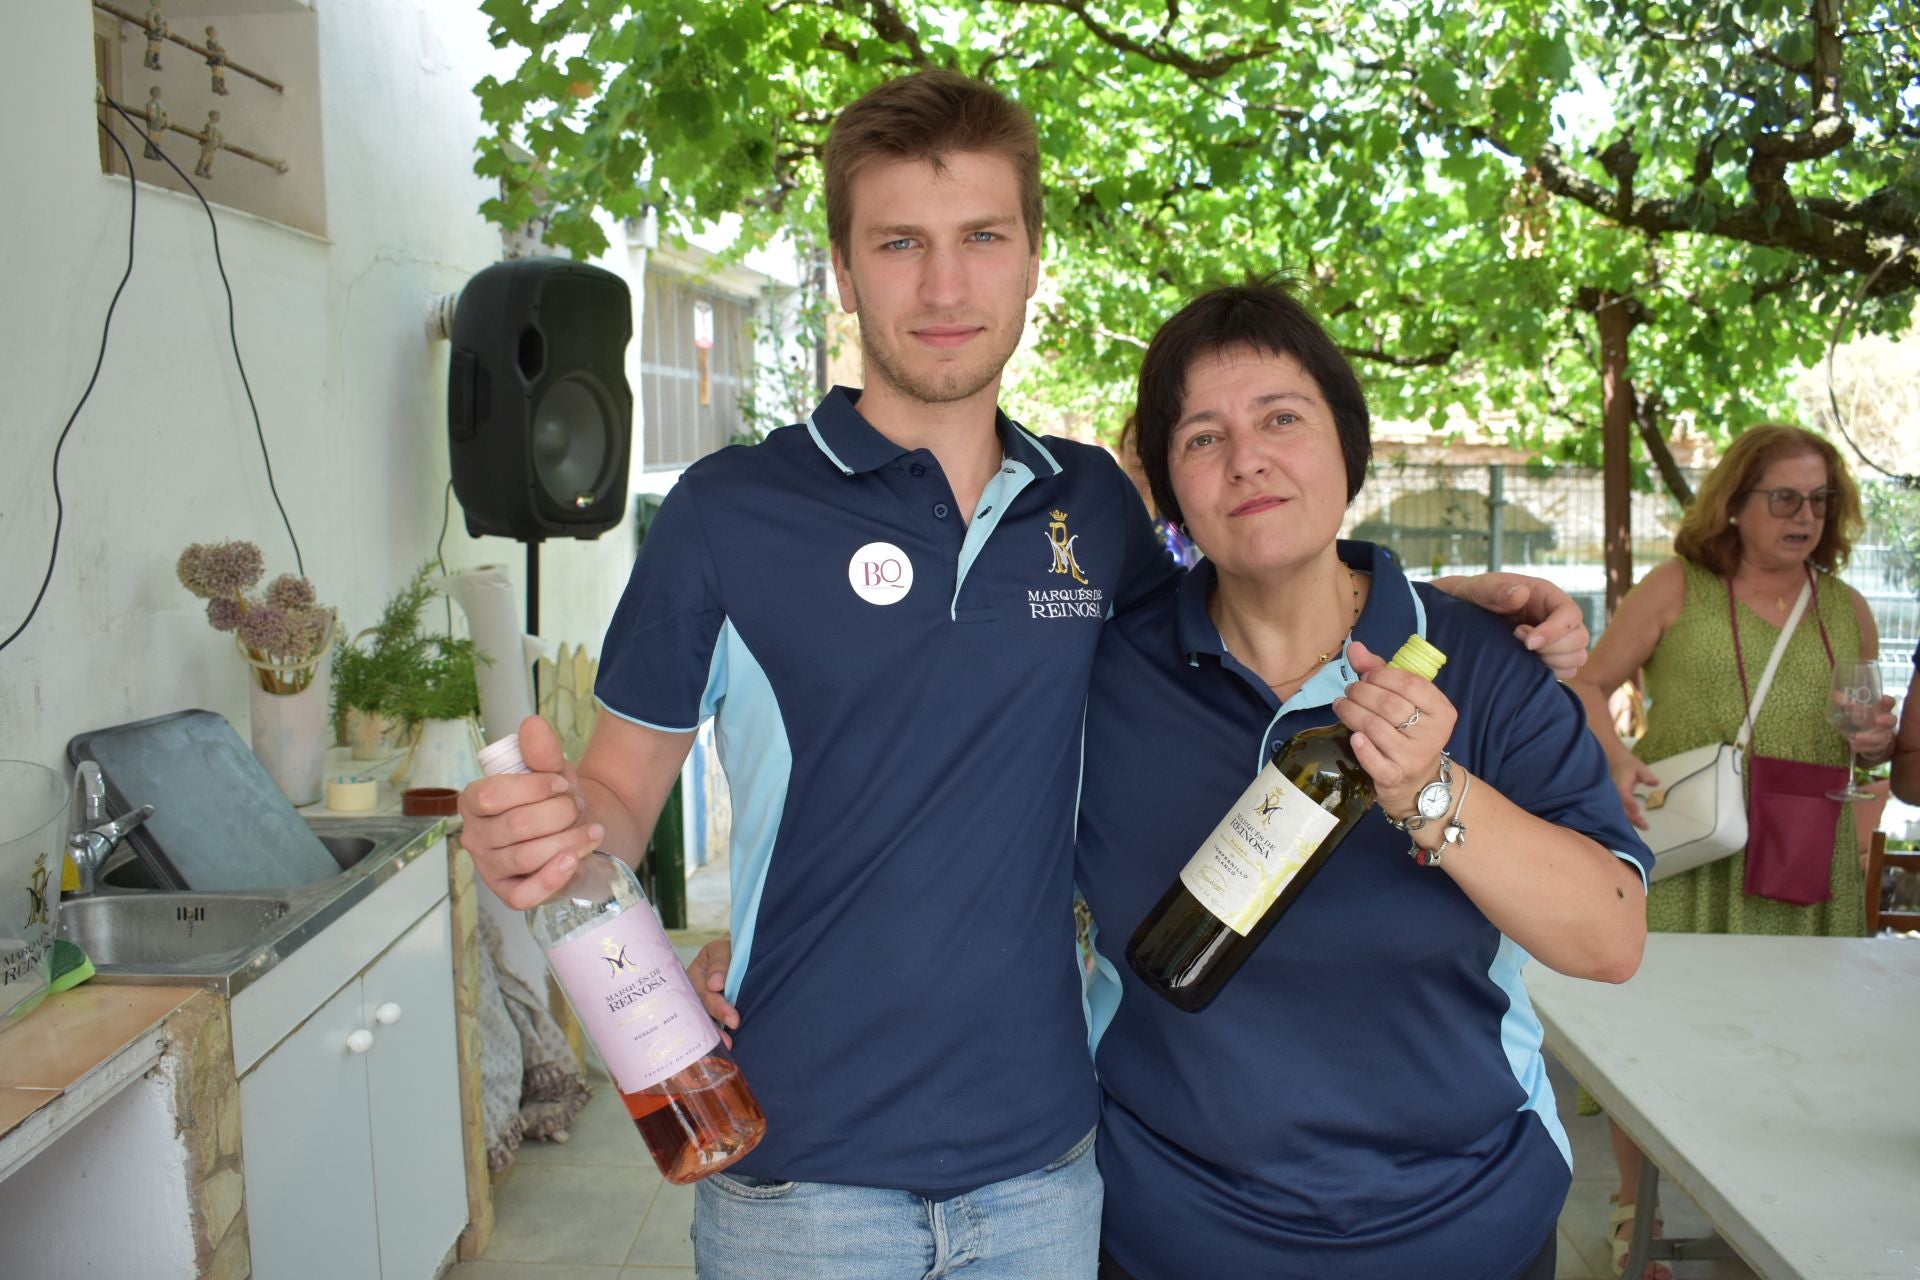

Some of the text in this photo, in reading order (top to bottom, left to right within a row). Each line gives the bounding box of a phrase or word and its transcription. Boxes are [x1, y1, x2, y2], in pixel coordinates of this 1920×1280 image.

[857, 558, 904, 588] BQ
[1027, 587, 1102, 601] MARQUÉS DE
[1031, 602, 1102, 618] REINOSA
[1230, 819, 1270, 859] REINOSA
[1264, 838, 1276, 850] DE
[1215, 855, 1236, 876] BLANCO
[605, 975, 649, 1003] MARQUÉS
[608, 976, 667, 1013] REINOSA
